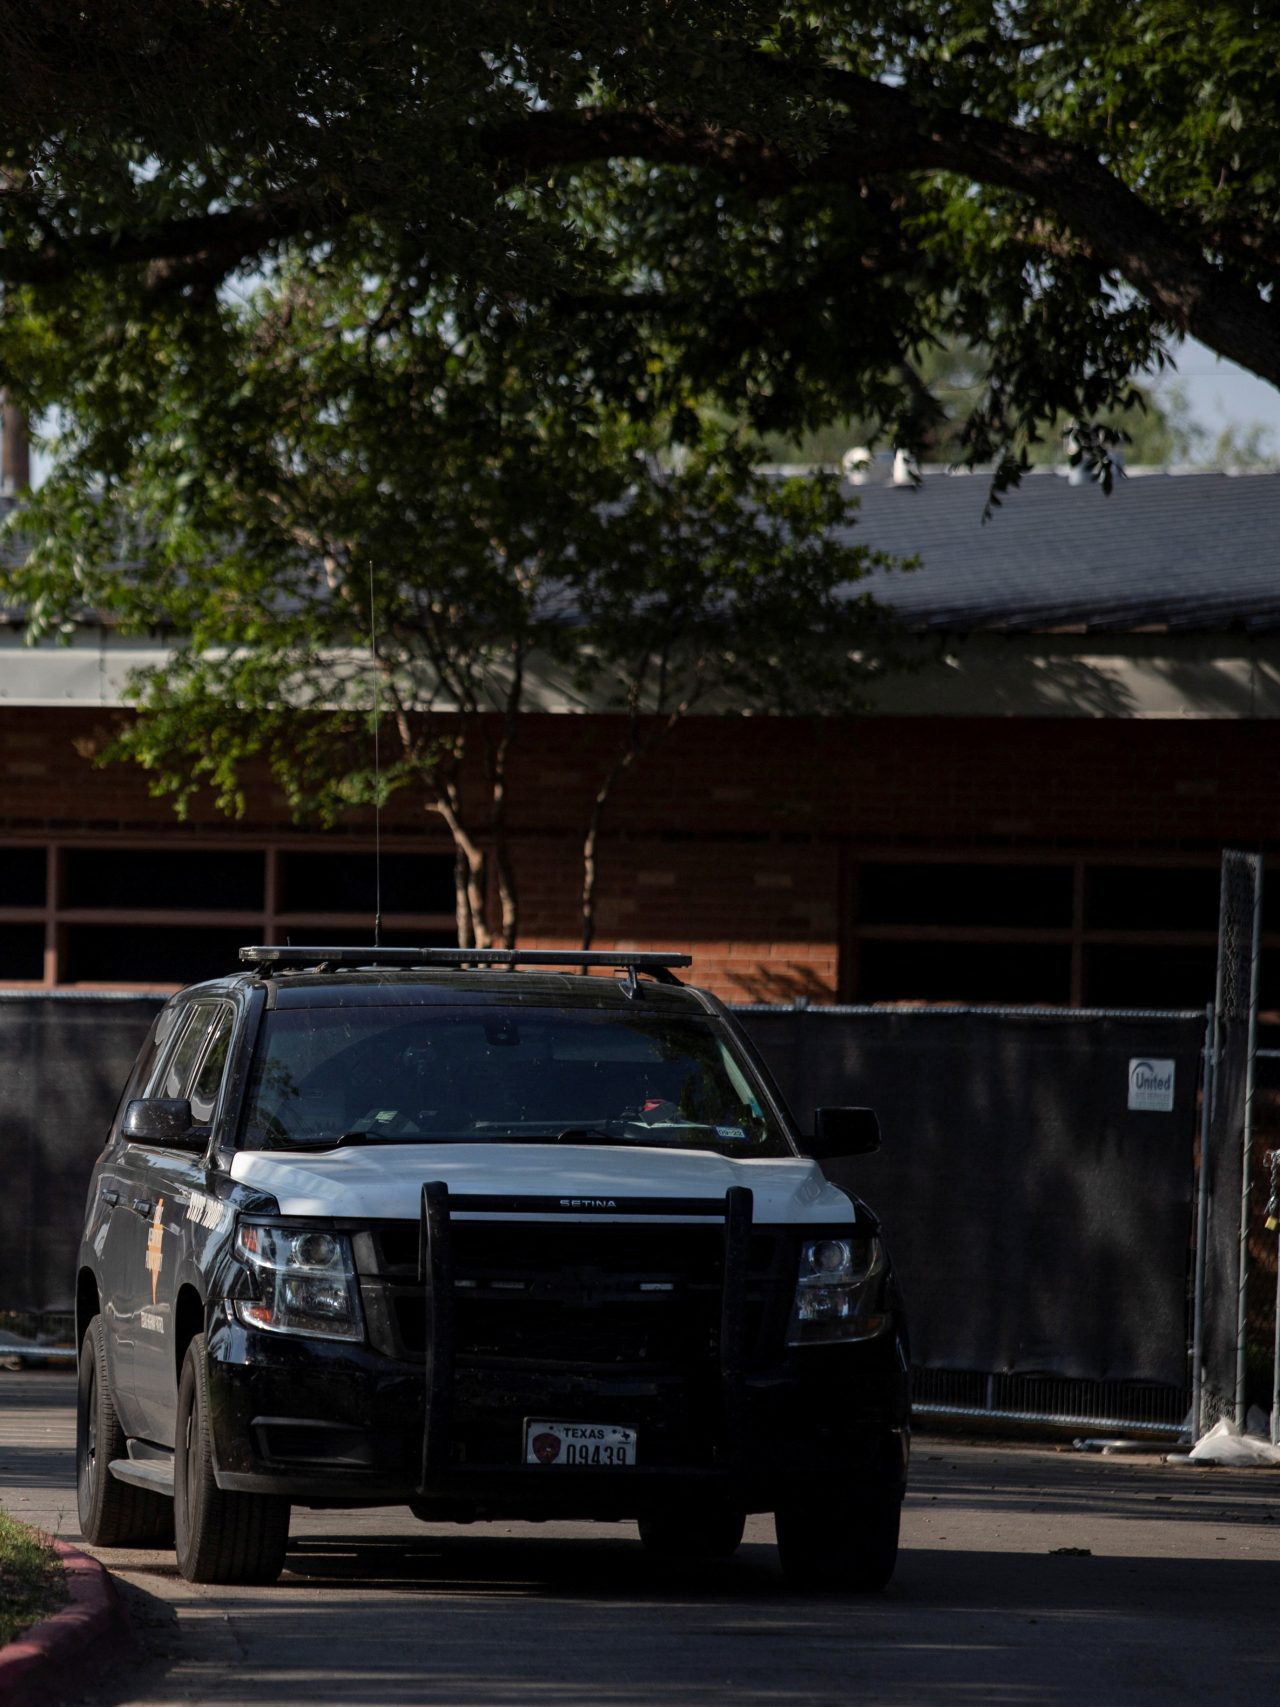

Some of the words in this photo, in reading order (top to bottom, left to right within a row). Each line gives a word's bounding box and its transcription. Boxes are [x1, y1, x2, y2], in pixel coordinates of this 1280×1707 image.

[1136, 1072, 1171, 1090] United
[560, 1199, 617, 1208] SETINA
[563, 1427, 605, 1440] TEXAS
